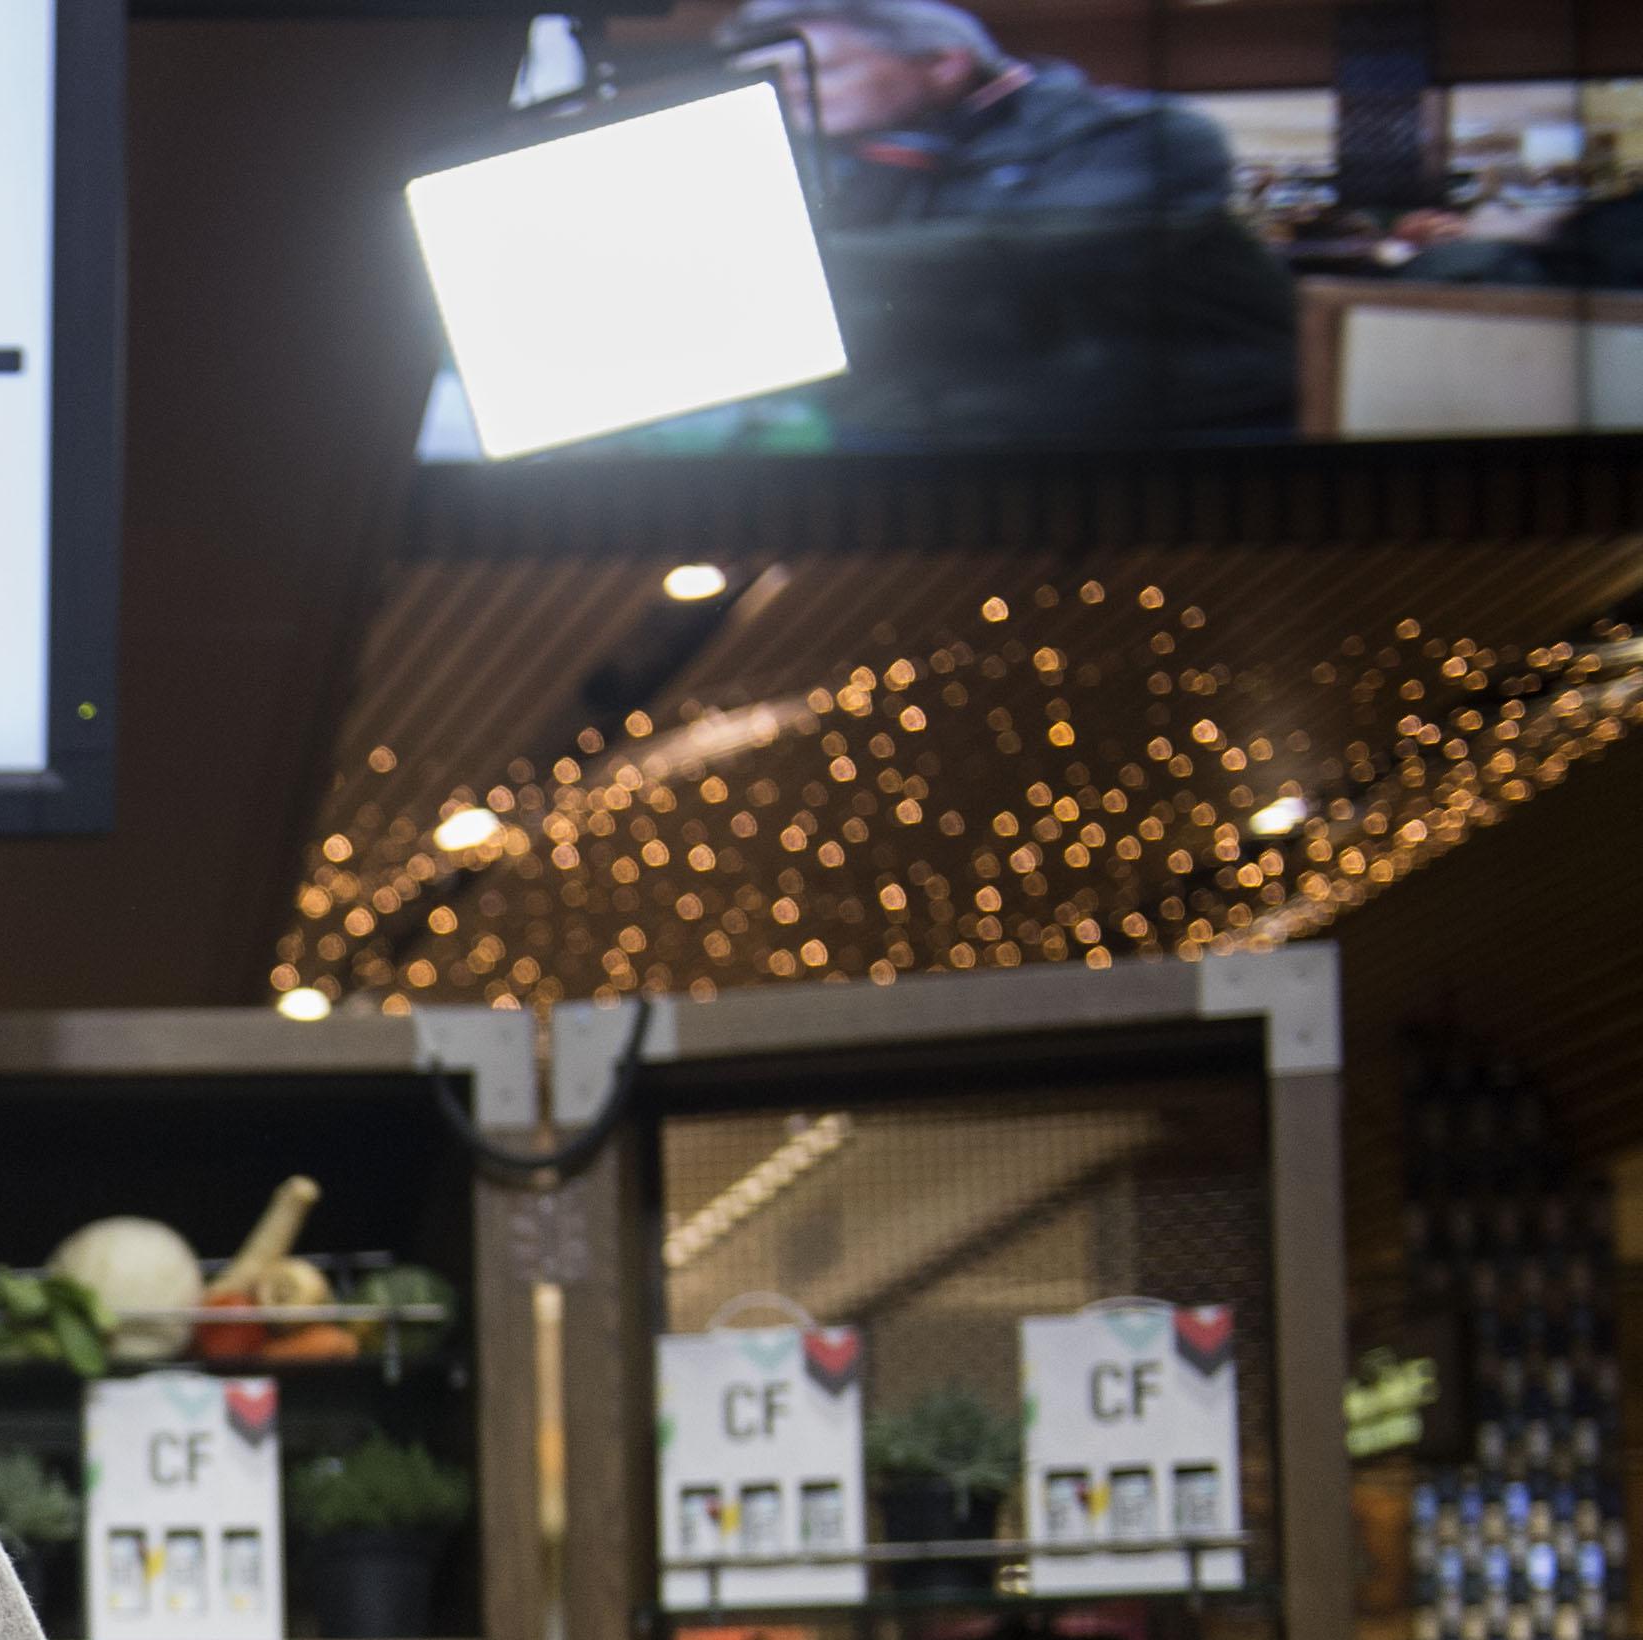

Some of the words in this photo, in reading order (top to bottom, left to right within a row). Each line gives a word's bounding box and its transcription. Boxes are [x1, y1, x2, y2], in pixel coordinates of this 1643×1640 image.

[721, 1381, 791, 1441] CF
[1089, 1360, 1160, 1423] CF
[147, 1431, 211, 1488] CF
